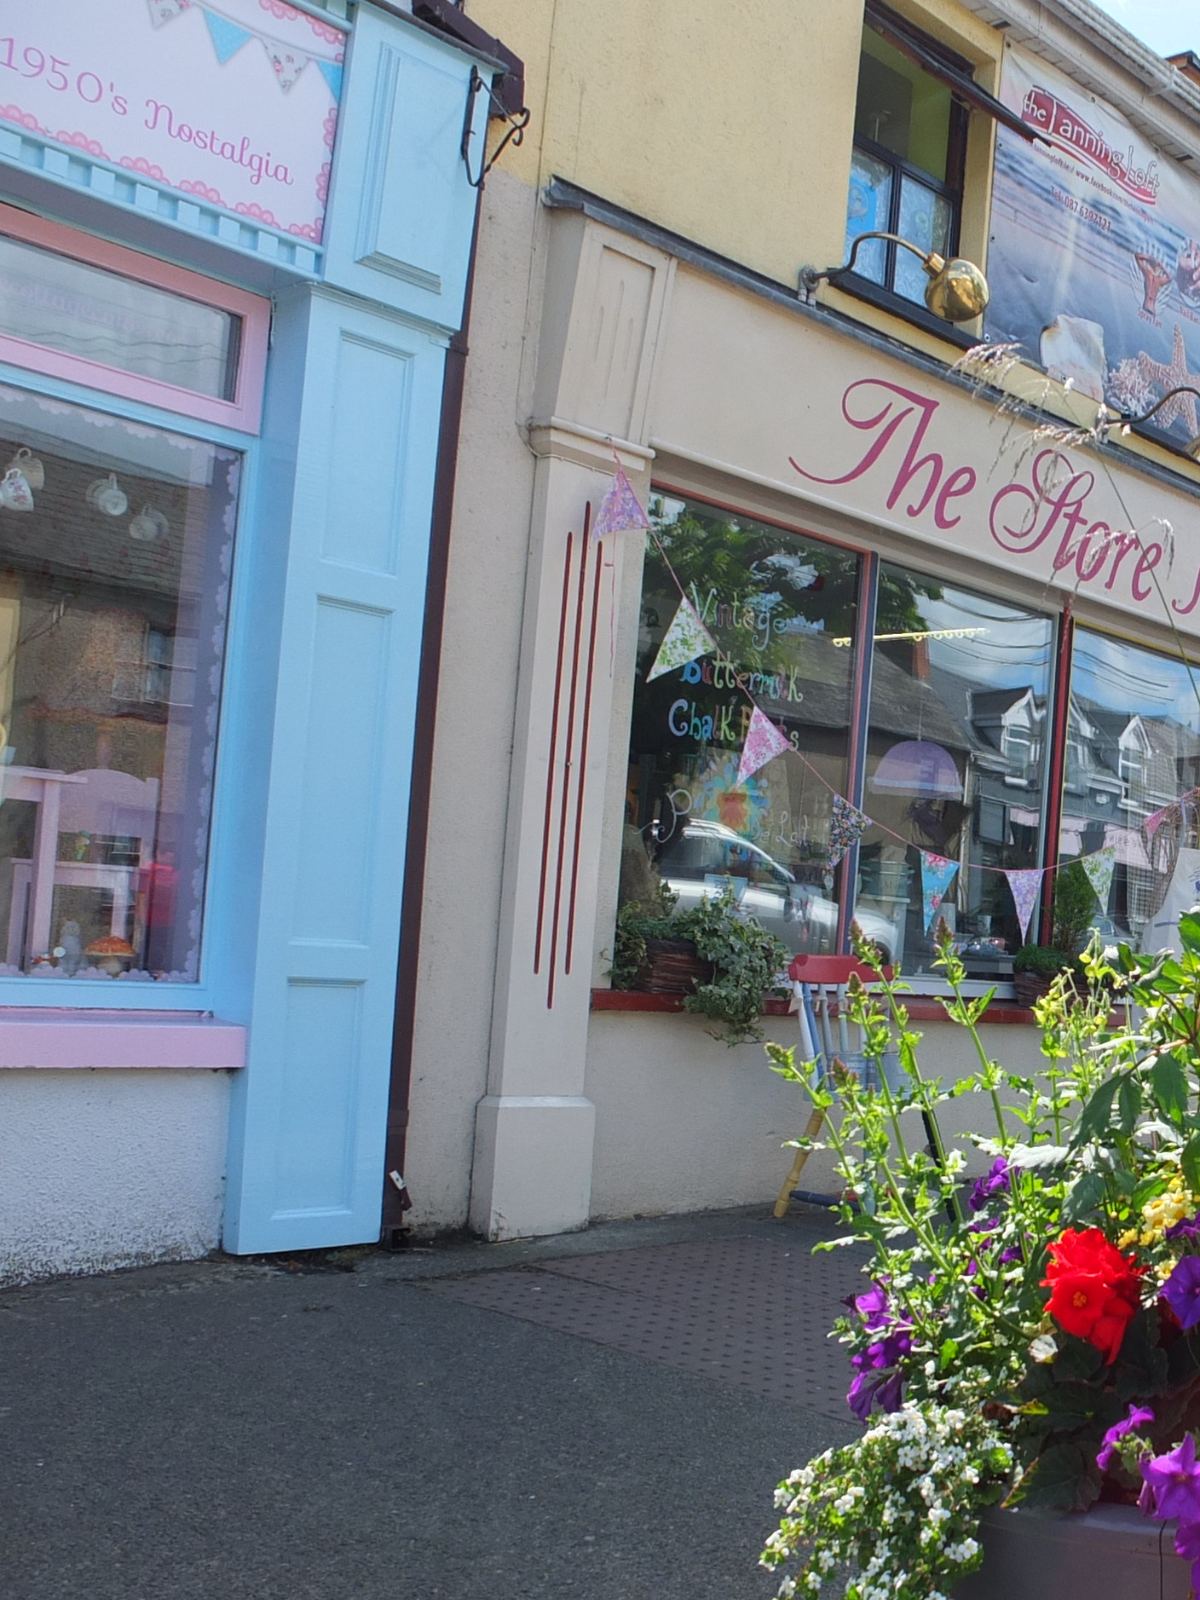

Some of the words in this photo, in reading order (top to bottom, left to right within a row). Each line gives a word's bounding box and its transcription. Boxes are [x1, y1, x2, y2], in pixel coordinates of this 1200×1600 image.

[0, 36, 129, 117] 1950's
[144, 98, 294, 186] Nostalgia
[1024, 91, 1047, 122] the
[1033, 85, 1124, 180] Tanning
[1125, 145, 1160, 196] Loft
[788, 378, 977, 530] The
[989, 448, 1163, 602] Store
